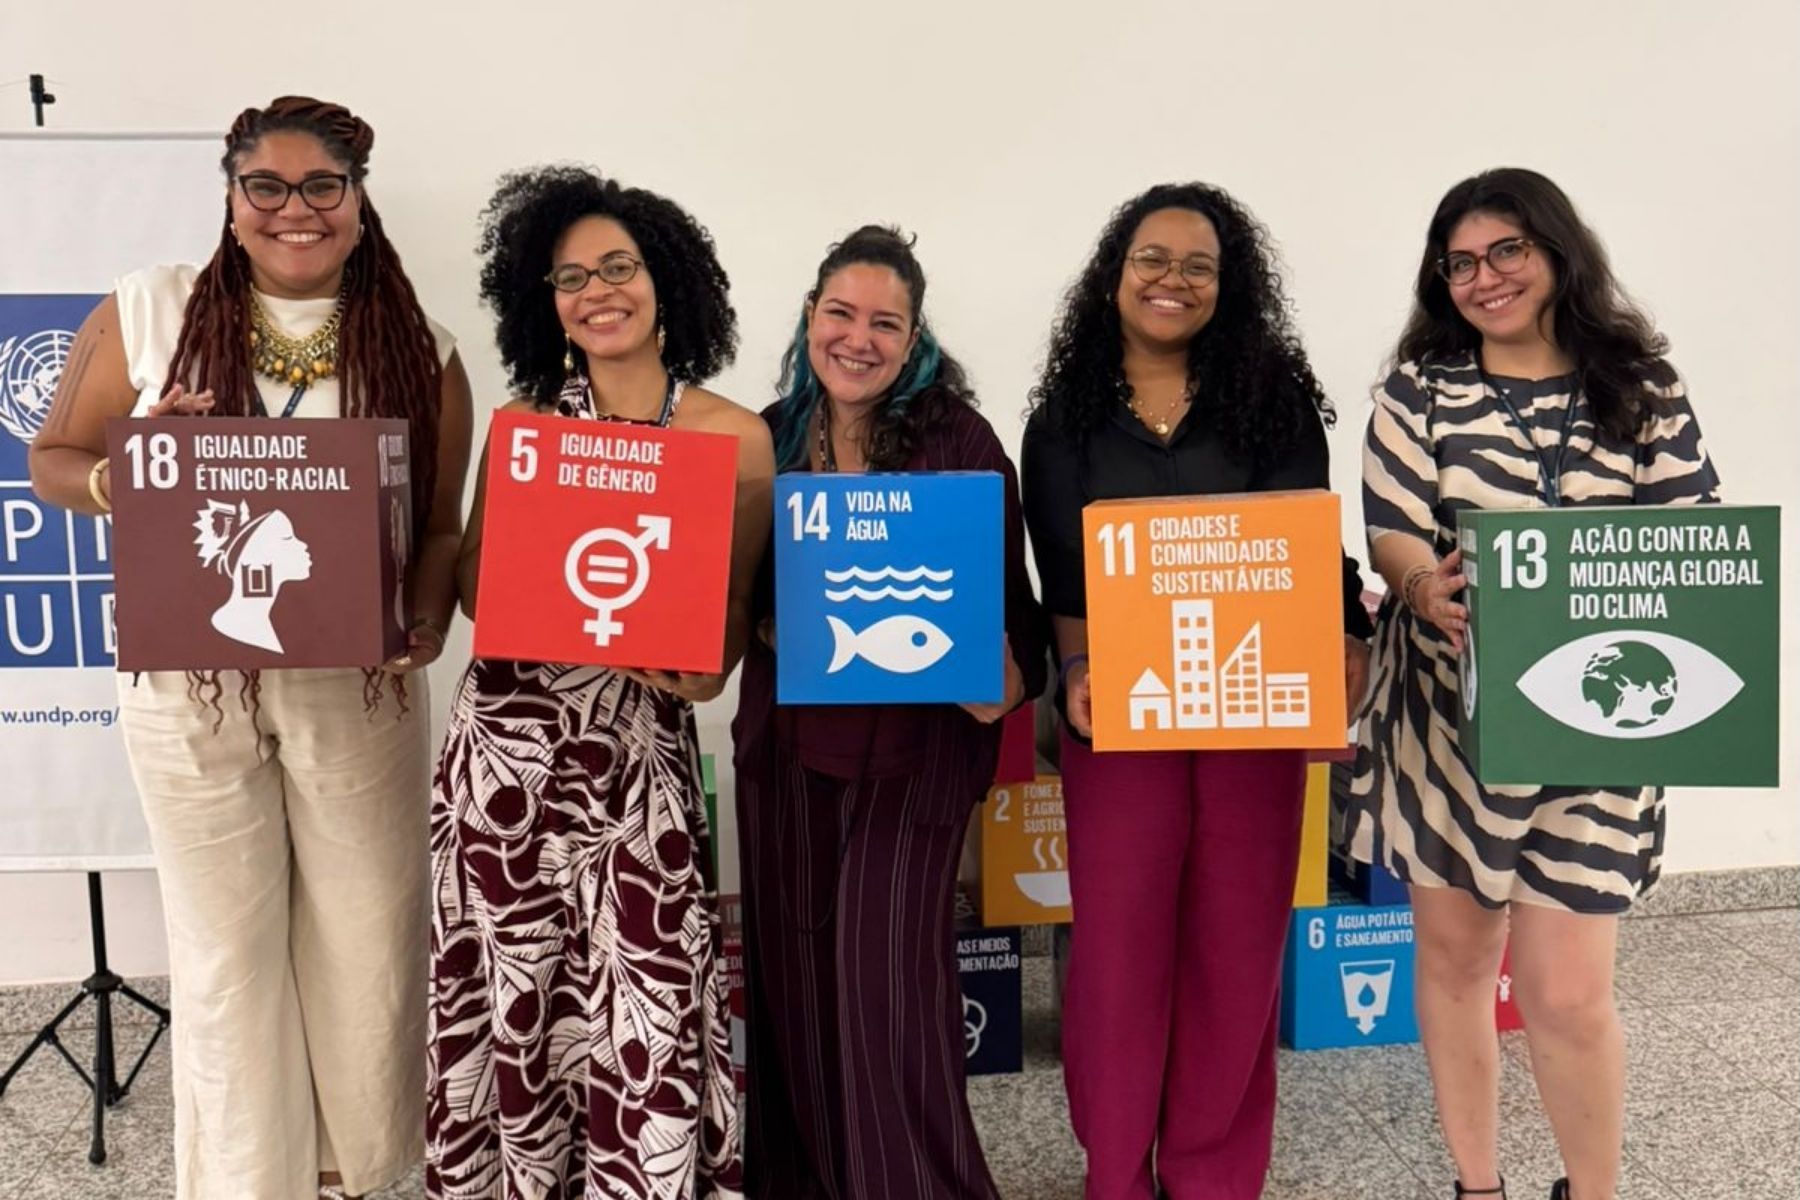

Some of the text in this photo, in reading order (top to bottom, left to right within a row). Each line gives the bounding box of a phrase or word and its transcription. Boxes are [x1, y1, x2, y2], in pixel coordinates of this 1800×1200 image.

[124, 433, 180, 490] 18
[194, 435, 307, 459] IGUALDADE
[510, 427, 539, 482] 5
[560, 433, 665, 466] IGUALDADE
[195, 463, 350, 491] ÉTNICO-RACIAL
[558, 463, 657, 494] DE GÊNERO
[787, 491, 830, 541] 14
[846, 491, 912, 512] VIDA NA
[846, 516, 888, 541] ÁGUA
[1150, 514, 1241, 541] CIDADES E
[1570, 523, 1751, 557] AÇÃO CONTRA A
[1097, 522, 1136, 576] 11
[1151, 538, 1289, 567] COMUNIDADES
[1493, 528, 1548, 589] 13
[1152, 566, 1293, 595] SUSTENTÁVEIS
[1569, 559, 1763, 590] MUDANÇA GLOBAL
[1569, 593, 1668, 620] DO CLIMA
[995, 789, 1010, 822] 2
[1024, 783, 1053, 799] FOME
[1024, 802, 1030, 816] E
[1308, 917, 1326, 949] 6
[1336, 910, 1415, 930] ÁGUA POTÁVEL
[1336, 929, 1413, 948] E SANEAMENTO
